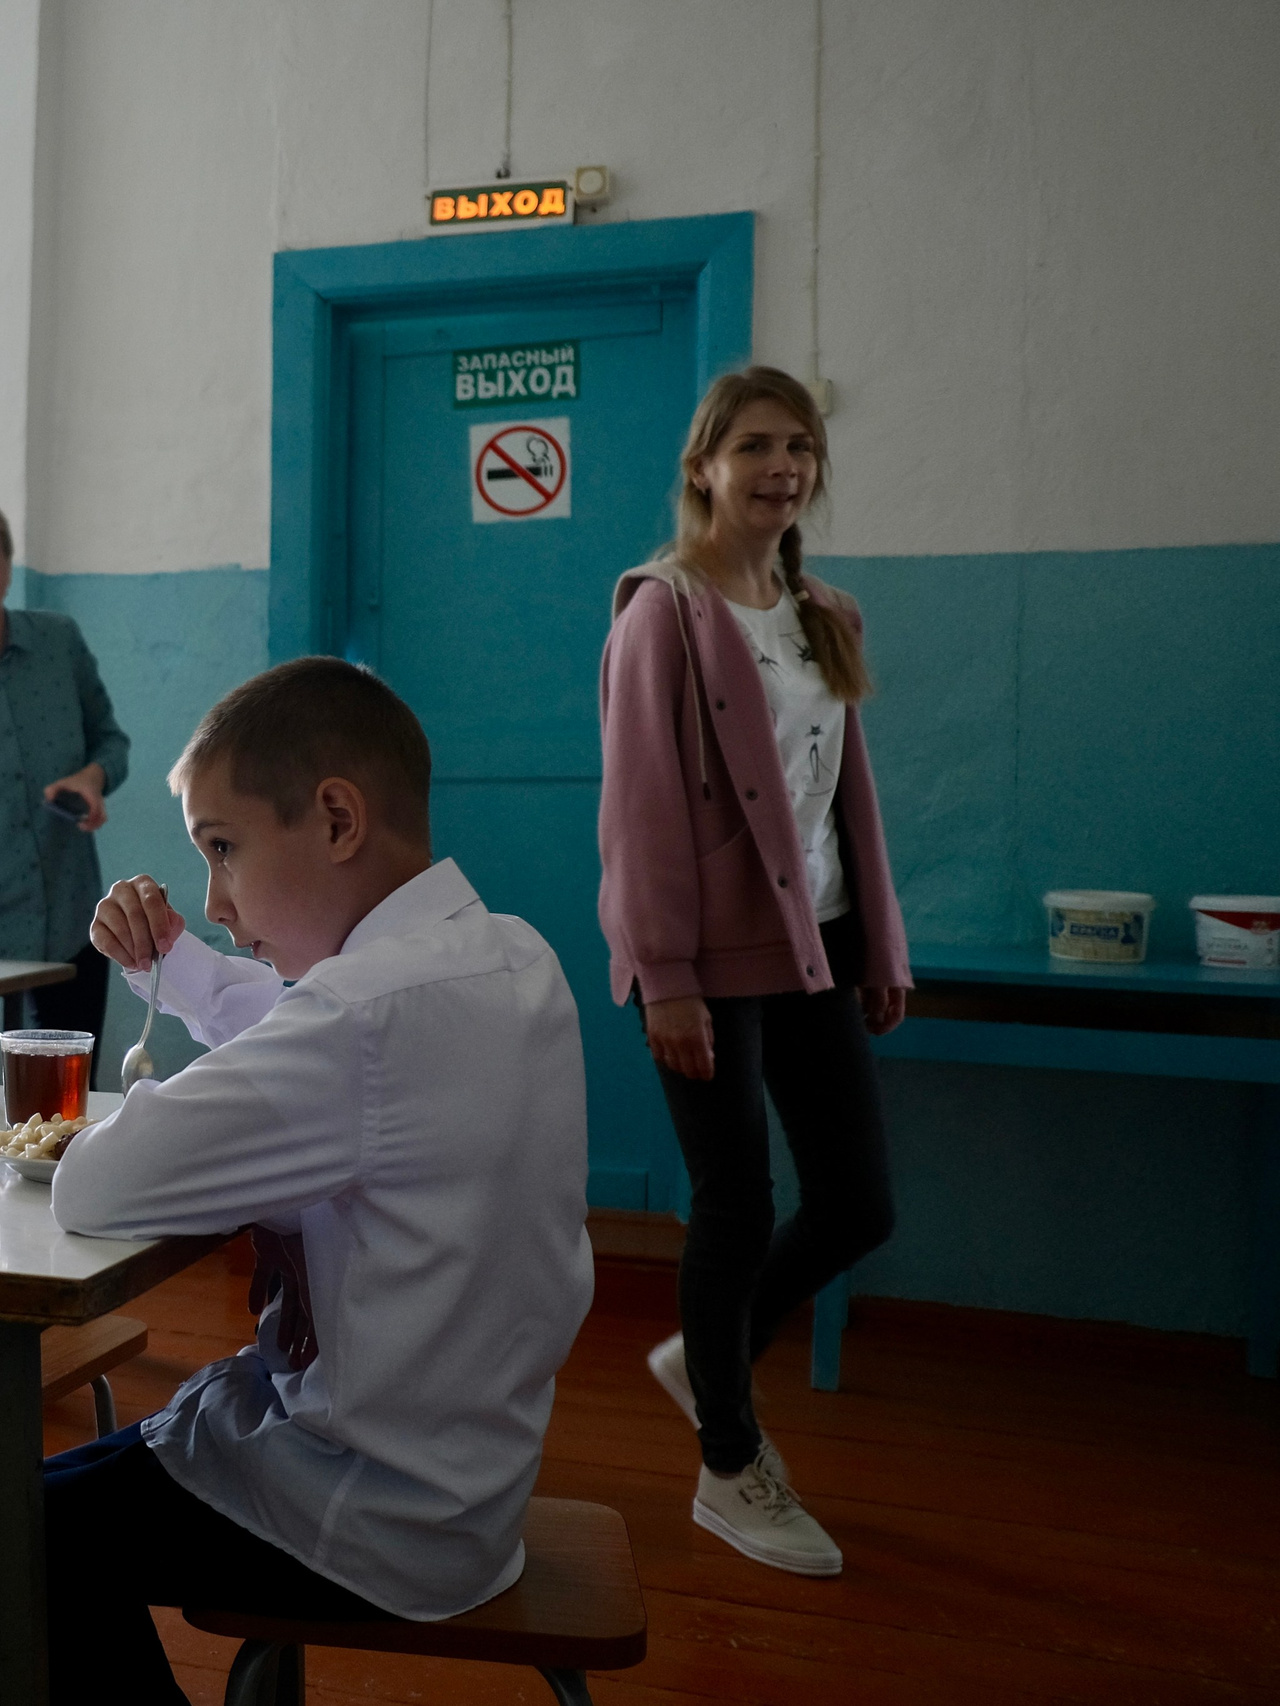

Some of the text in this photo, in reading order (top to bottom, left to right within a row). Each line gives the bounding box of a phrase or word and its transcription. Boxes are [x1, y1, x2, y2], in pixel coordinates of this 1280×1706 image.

[433, 188, 565, 221] ВЫХОД
[458, 345, 574, 371] ЗАПАСНЫЙ
[456, 366, 576, 400] ВЫХОД
